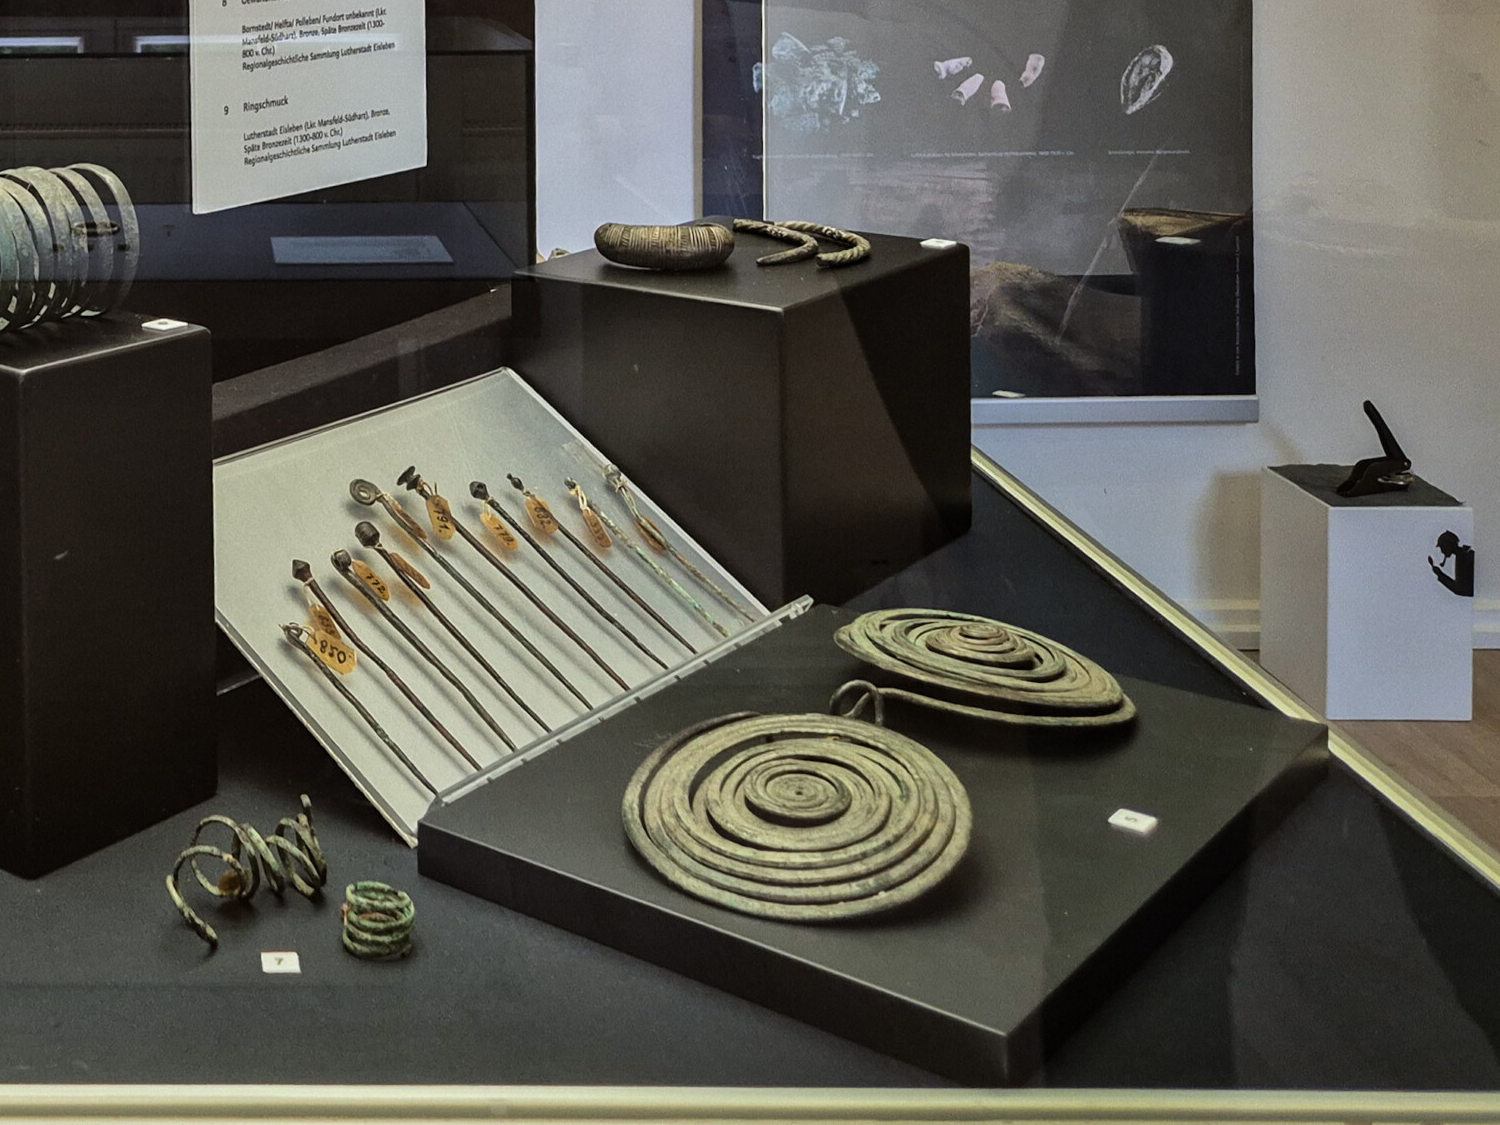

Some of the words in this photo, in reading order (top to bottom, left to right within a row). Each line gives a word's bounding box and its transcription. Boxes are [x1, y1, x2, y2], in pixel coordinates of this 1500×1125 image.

[223, 105, 229, 116] 9
[243, 96, 289, 113] Ringschmuck
[243, 143, 261, 154] Späte
[261, 137, 292, 150] Bronzezeit
[292, 130, 323, 145] (1300-800
[329, 126, 343, 137] Chr.)
[243, 146, 311, 166] Regionalgeschichtliche
[311, 141, 341, 152] Sammlung
[341, 133, 374, 146] Lutherstadt
[374, 130, 397, 140] Eisleben
[274, 956, 284, 966] 7
